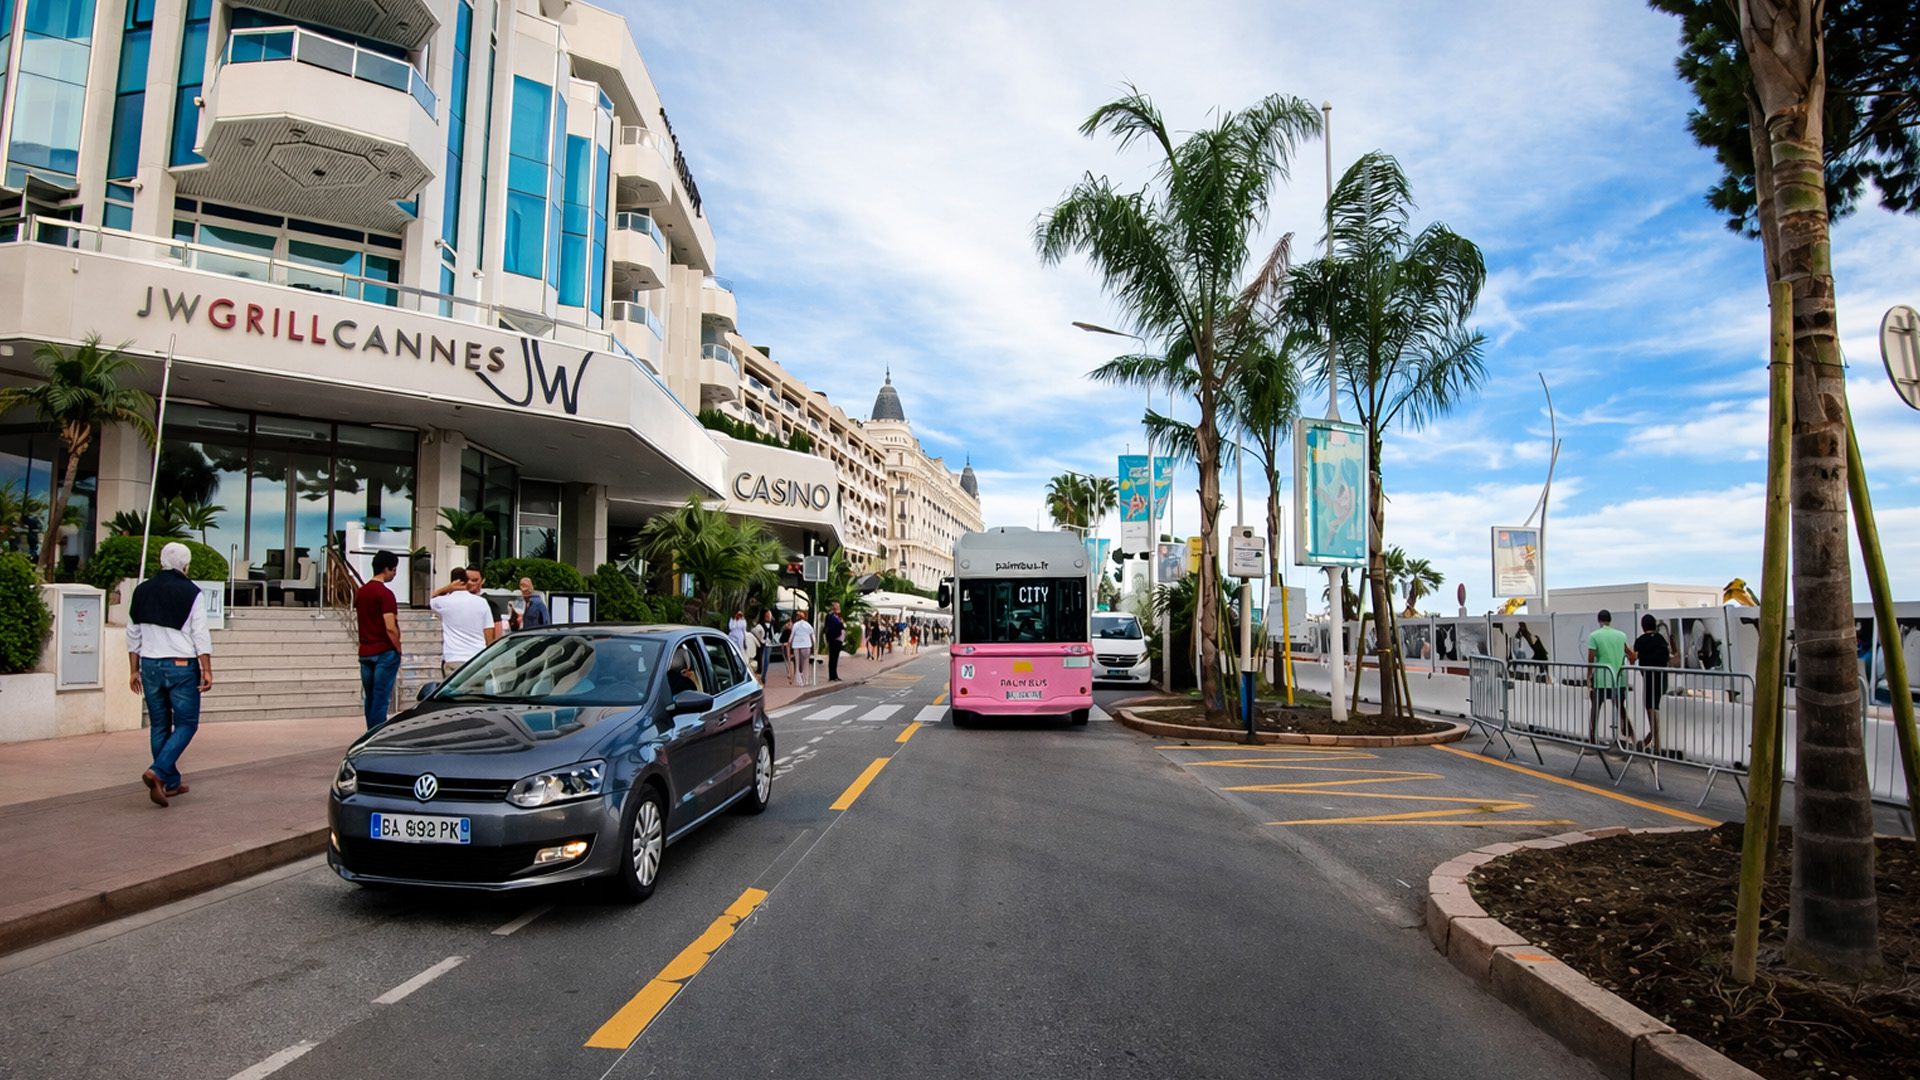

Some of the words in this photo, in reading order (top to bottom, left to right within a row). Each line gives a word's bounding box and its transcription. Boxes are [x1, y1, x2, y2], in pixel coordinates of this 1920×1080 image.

[474, 336, 595, 415] JW
[732, 471, 831, 511] CASINO
[1018, 586, 1049, 603] CITY
[440, 821, 460, 840] PK
